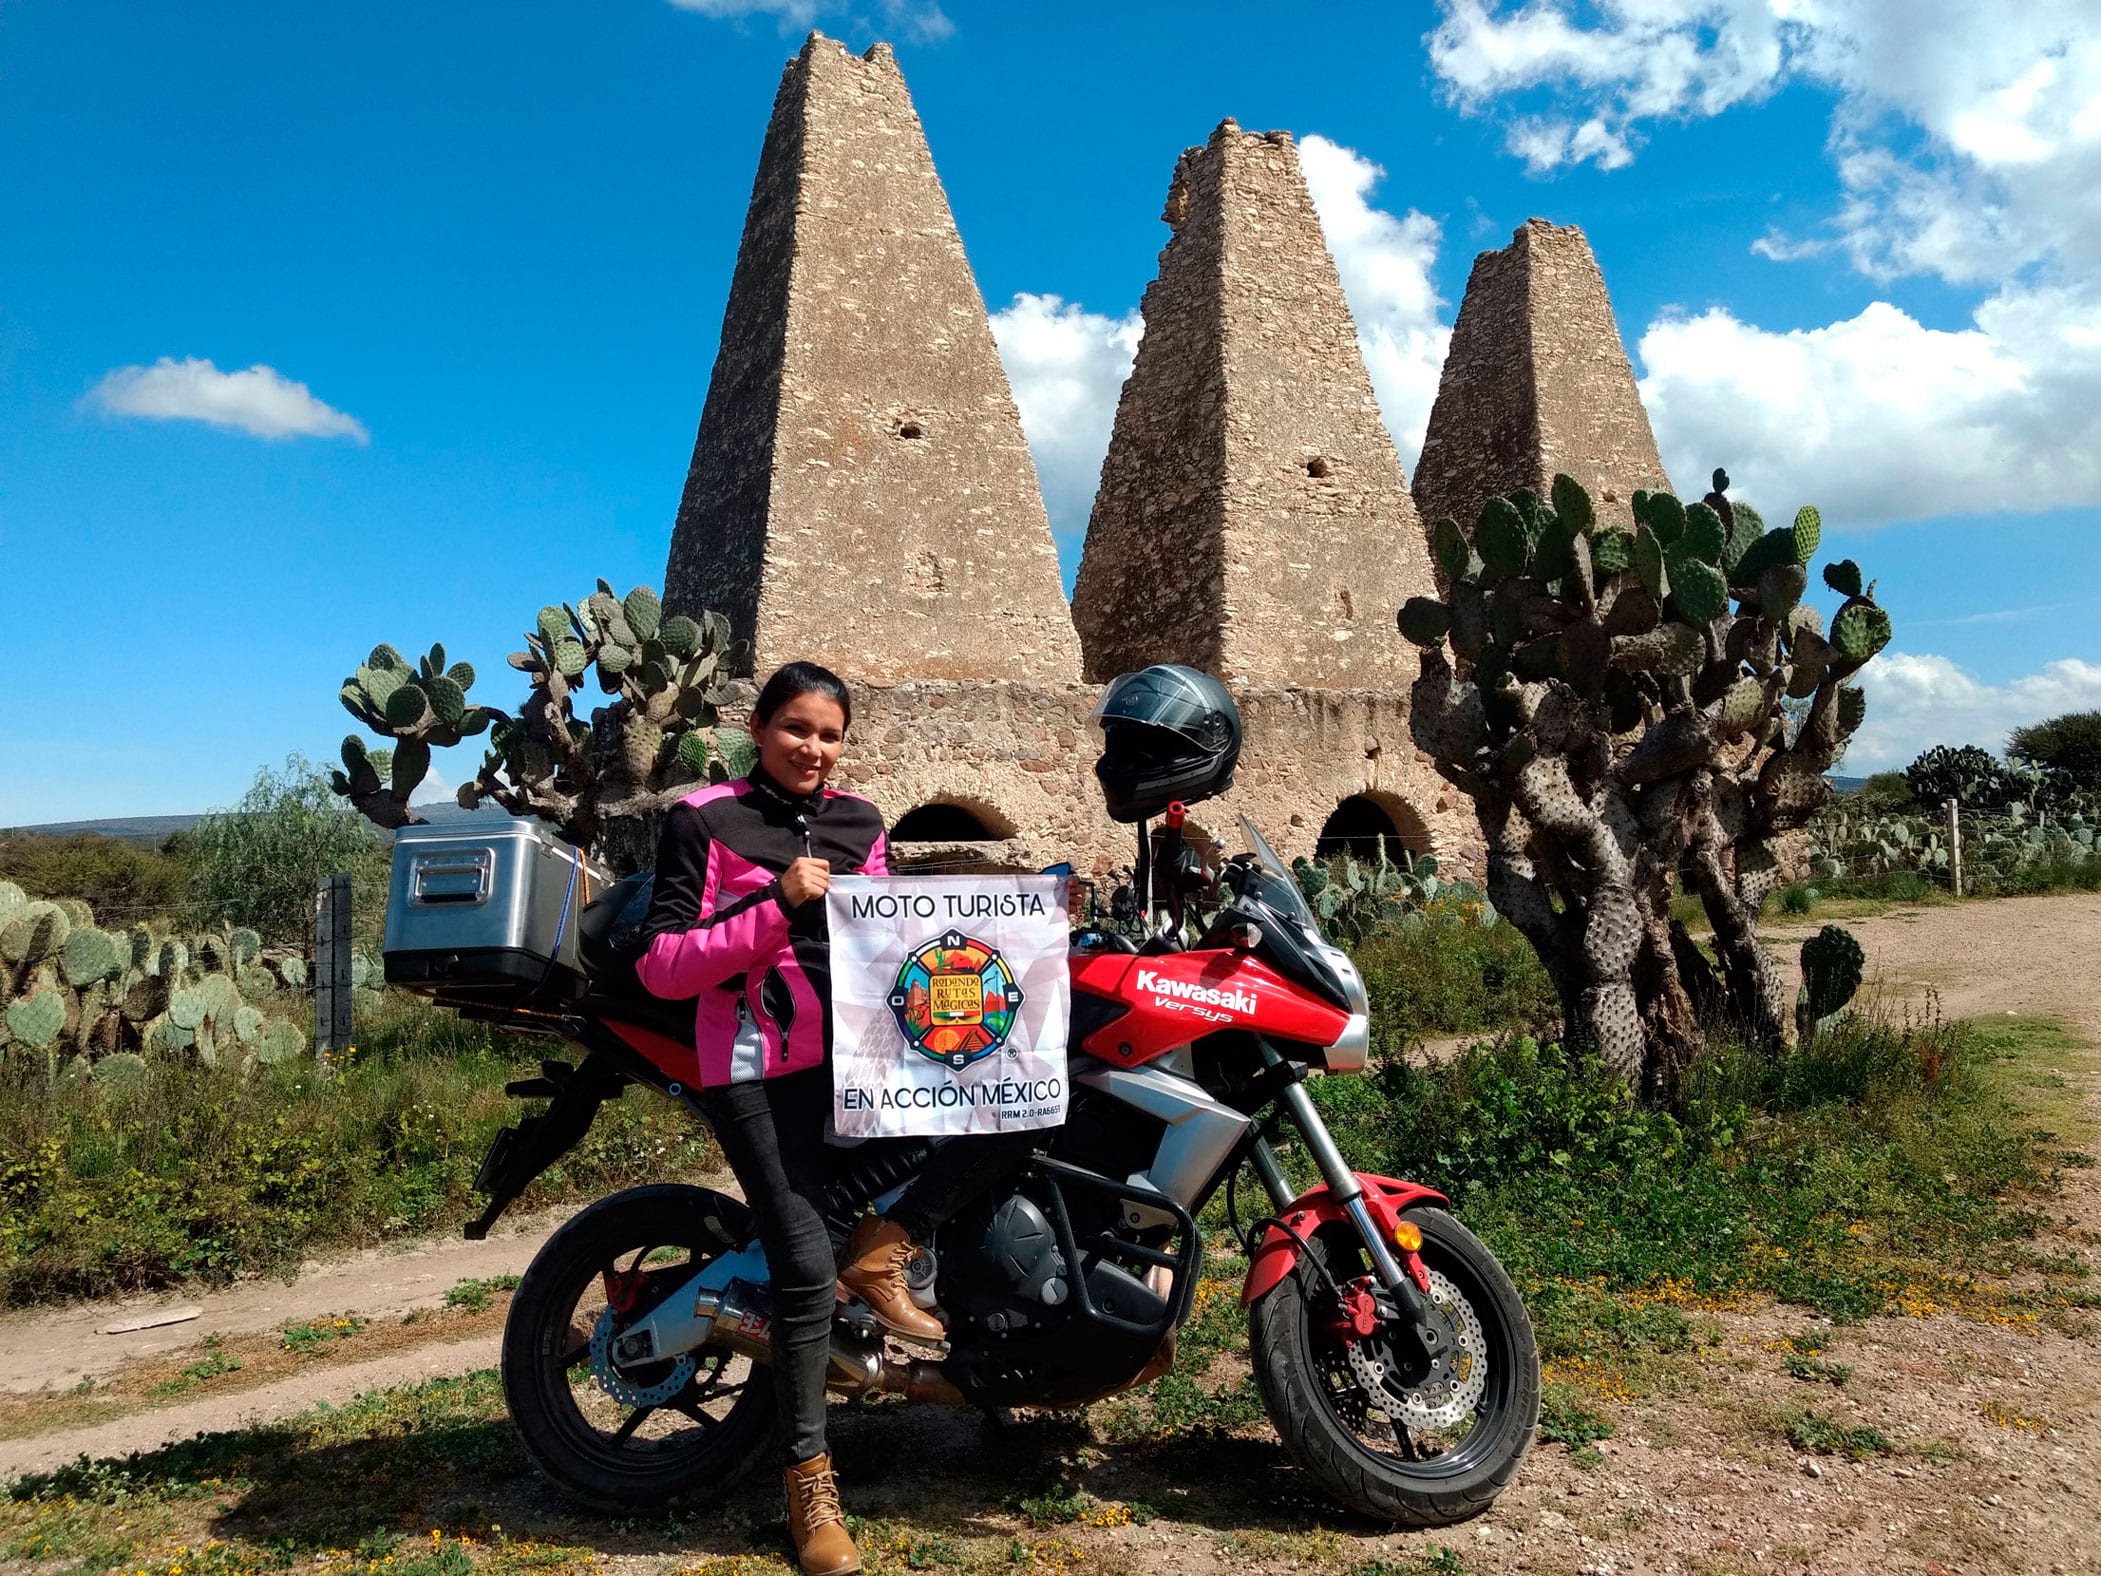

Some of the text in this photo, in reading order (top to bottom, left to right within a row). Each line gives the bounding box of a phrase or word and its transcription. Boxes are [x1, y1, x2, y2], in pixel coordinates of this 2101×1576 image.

[852, 894, 1046, 918] MOTO TURISTA
[947, 936, 961, 946] N
[1008, 992, 1020, 1002] E
[1137, 970, 1257, 1015] Kawasaki
[953, 1054, 965, 1064] S
[844, 1077, 1061, 1109] EN ACCIÓN MÉXICO
[1001, 1111, 1021, 1119] RRM
